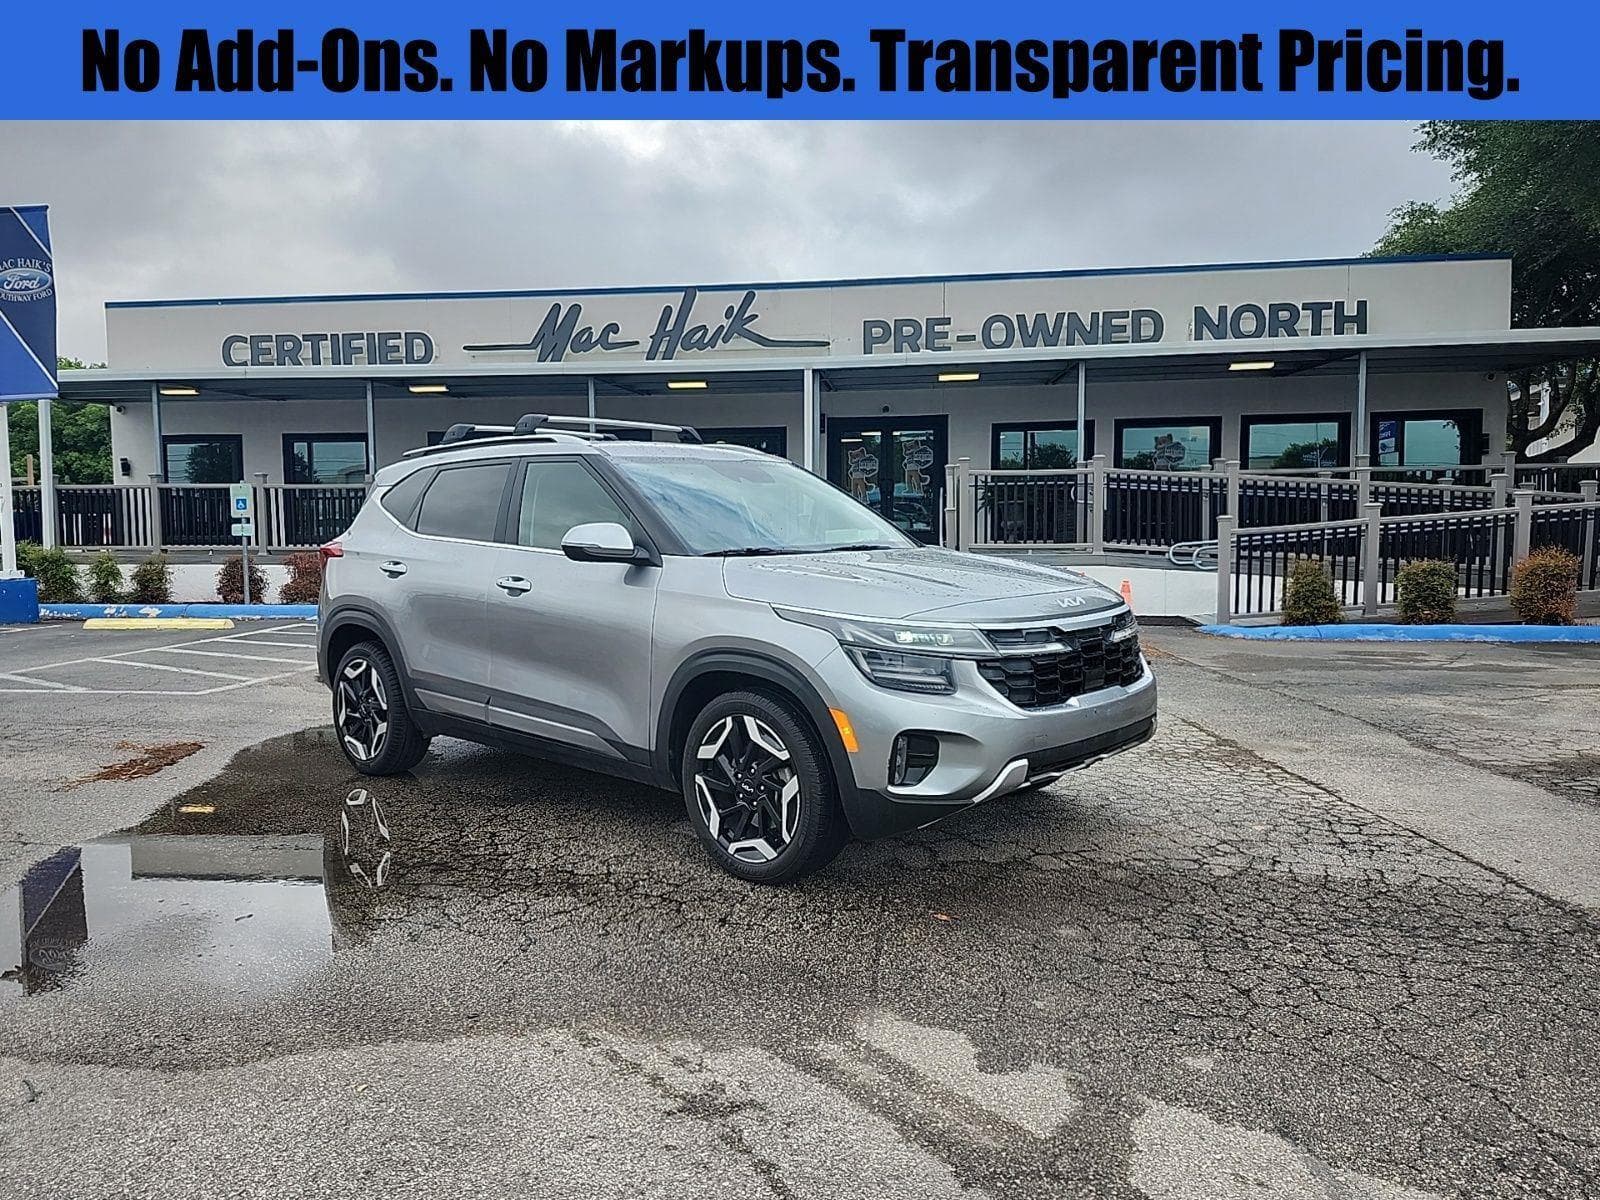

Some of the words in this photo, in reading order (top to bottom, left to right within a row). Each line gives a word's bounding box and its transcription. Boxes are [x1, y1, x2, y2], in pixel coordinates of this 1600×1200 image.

[0, 258, 15, 270] AC
[17, 257, 51, 273] HAIK'S
[4, 272, 41, 290] Ford
[32, 288, 53, 301] FORD
[221, 332, 434, 366] CERTIFIED
[462, 302, 640, 363] Mac
[645, 287, 831, 361] Haik
[862, 309, 1164, 355] PRE-OWNED
[1193, 299, 1368, 342] NORTH
